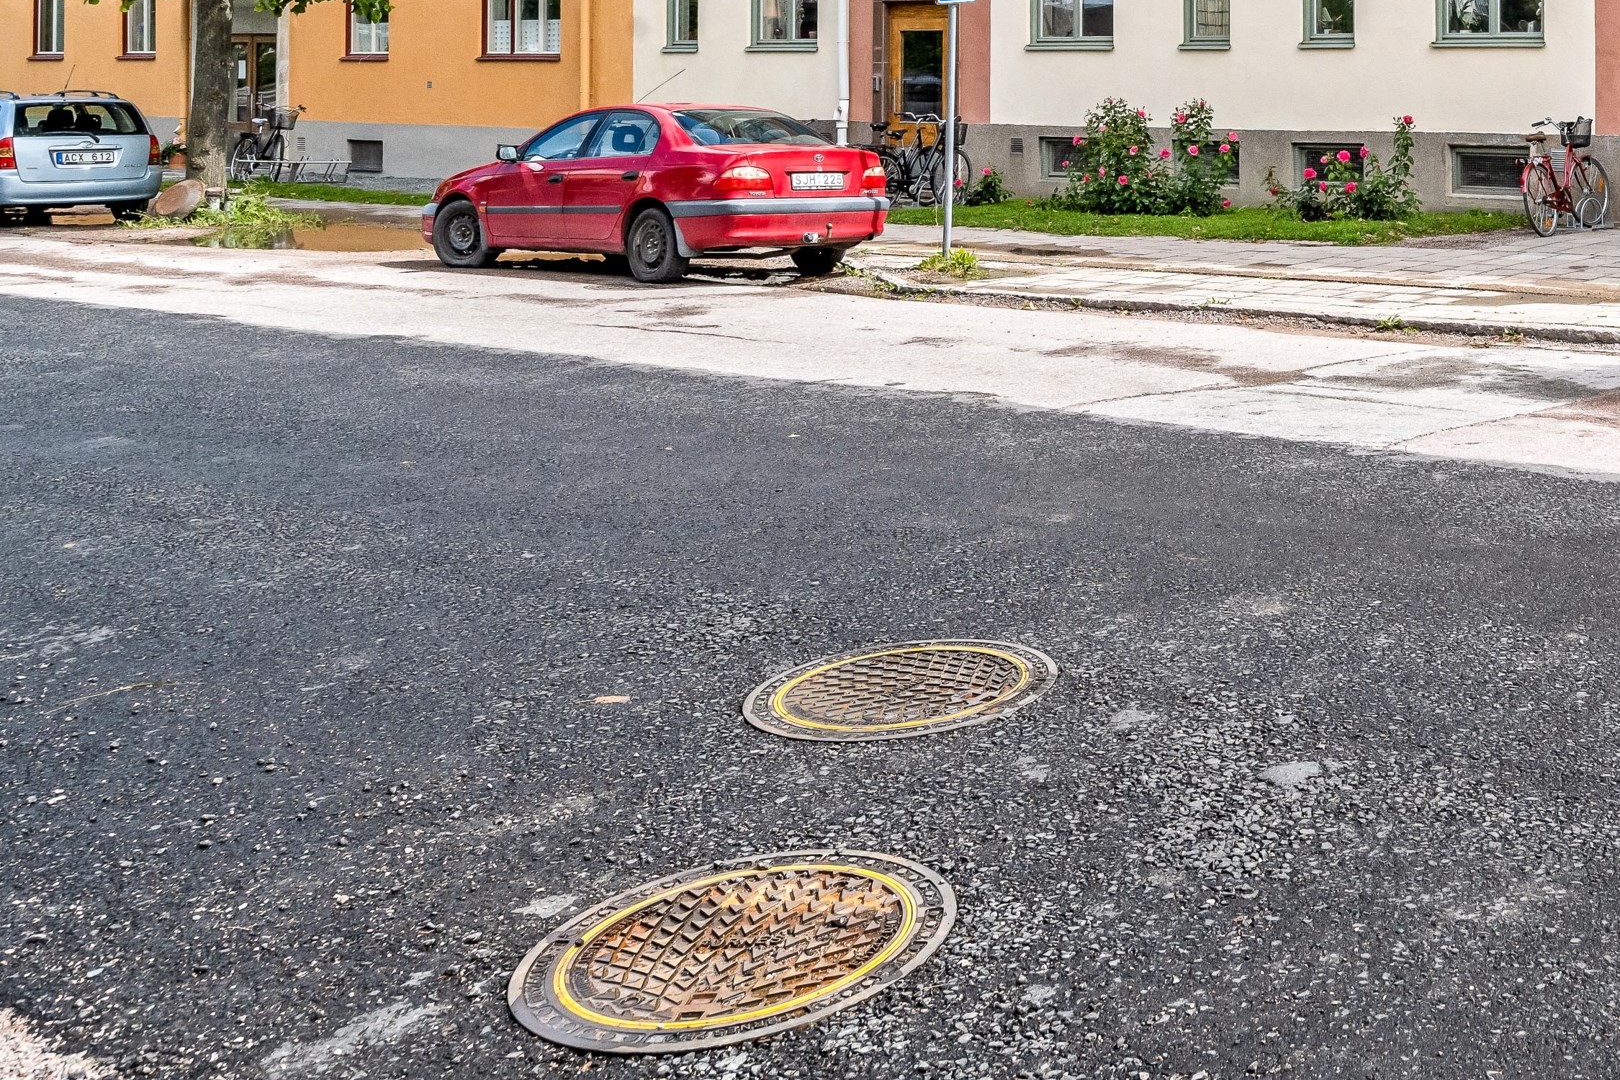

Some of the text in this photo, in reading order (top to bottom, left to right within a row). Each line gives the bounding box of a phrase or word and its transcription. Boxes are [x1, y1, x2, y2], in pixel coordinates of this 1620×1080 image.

[64, 152, 112, 162] ACX 612
[794, 174, 842, 185] SJH 225
